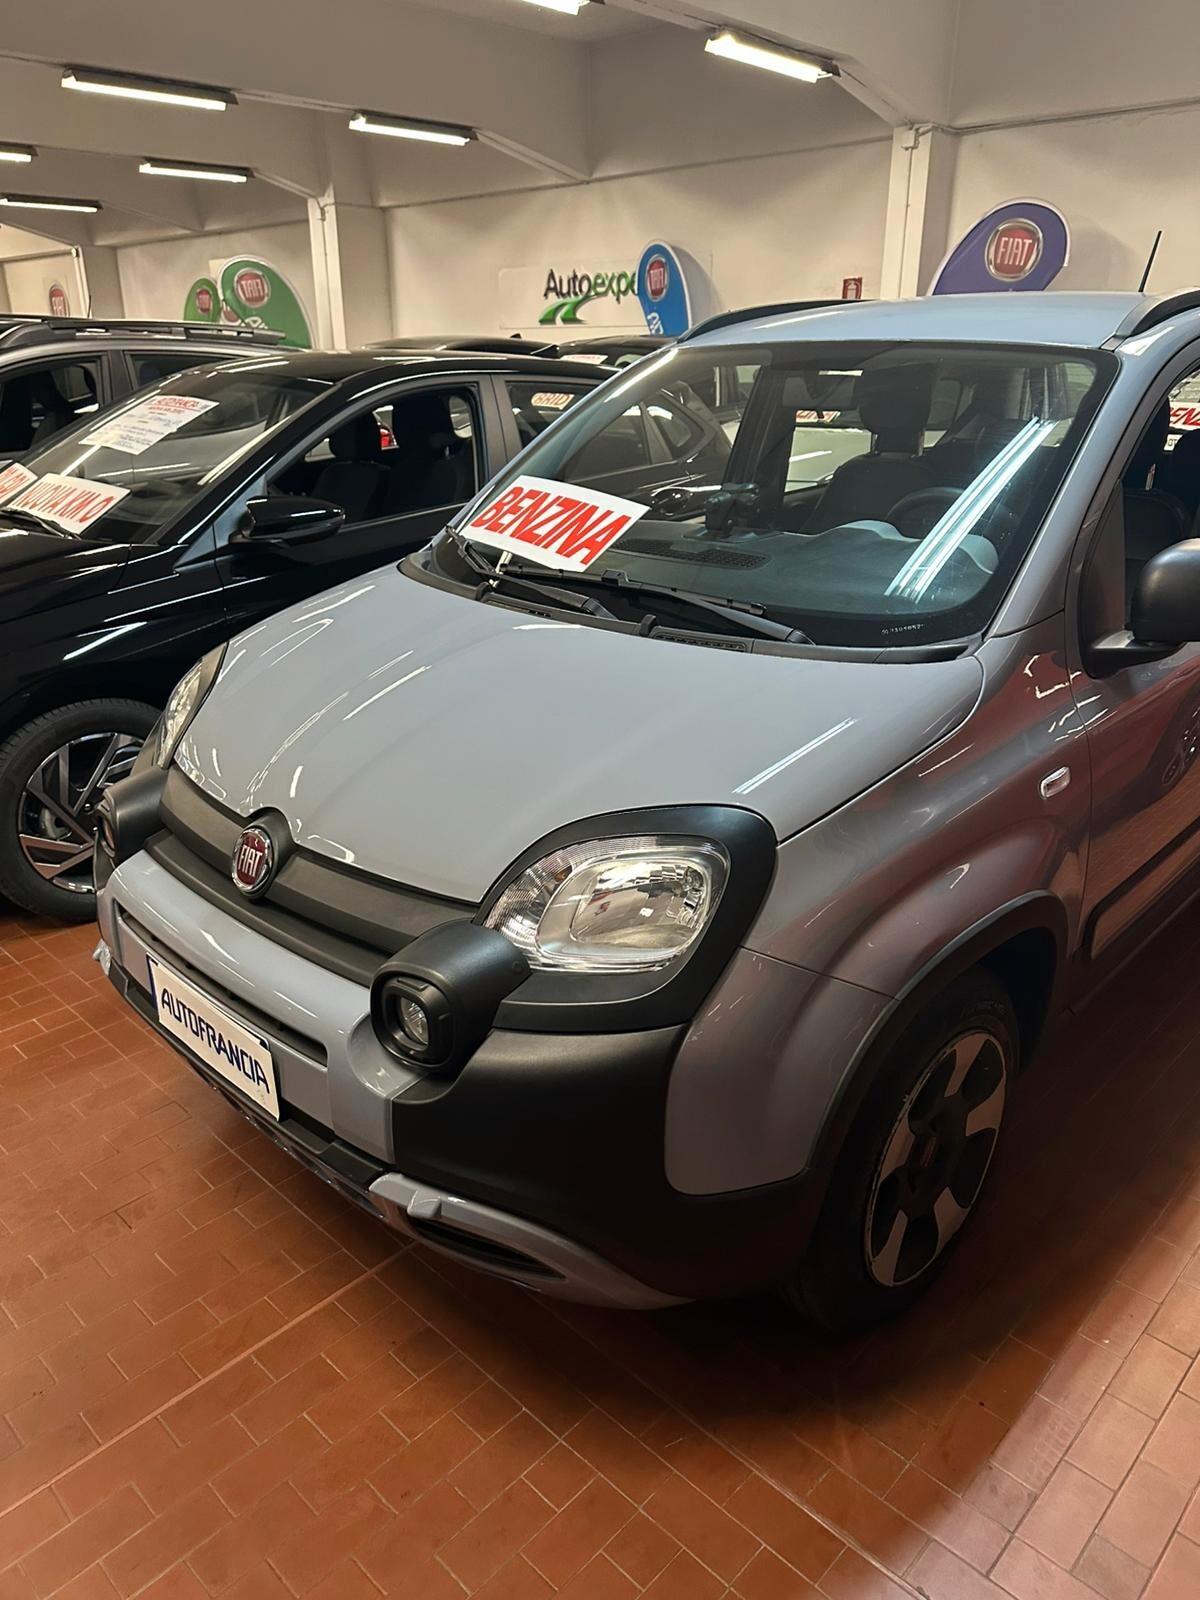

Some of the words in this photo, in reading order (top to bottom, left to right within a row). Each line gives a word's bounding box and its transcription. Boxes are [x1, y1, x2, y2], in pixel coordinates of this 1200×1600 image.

[996, 236, 1033, 266] FIAT
[471, 486, 632, 566] BENZINA
[237, 845, 263, 878] FIAT
[160, 987, 271, 1095] AUTOFRANCIA
